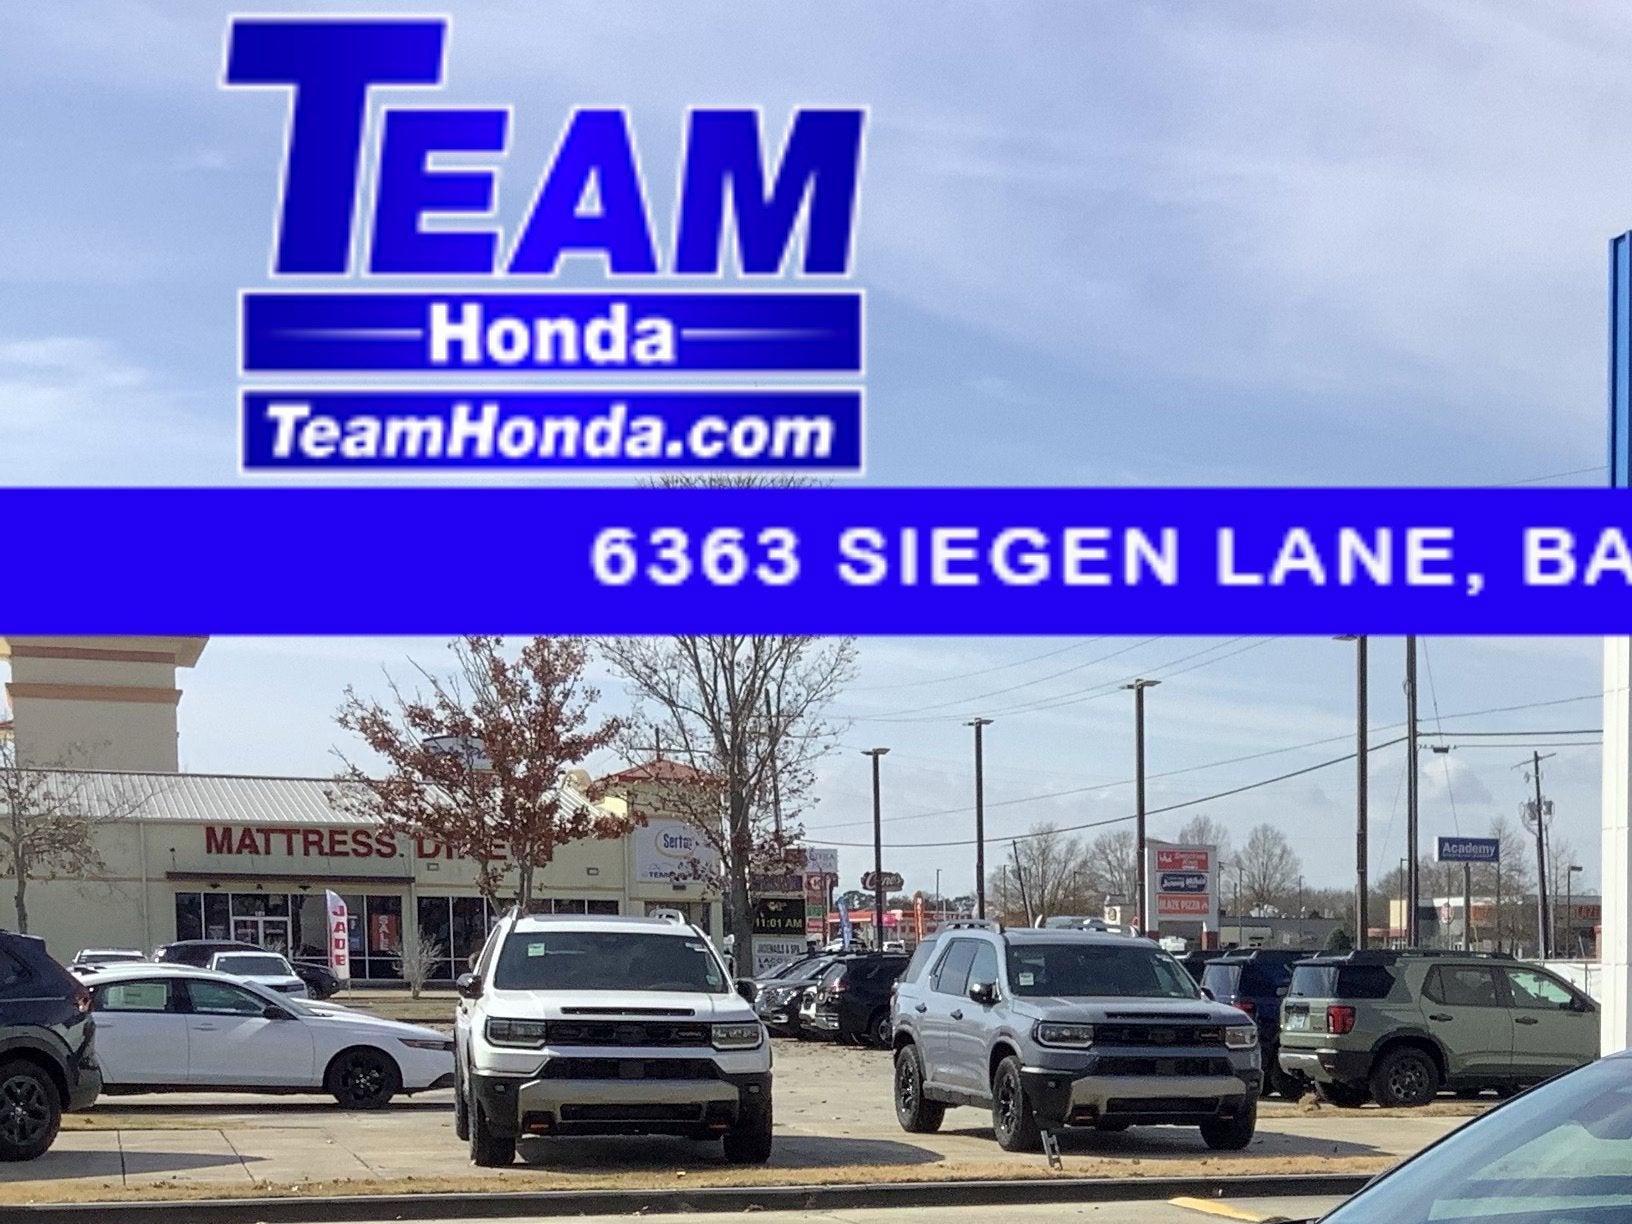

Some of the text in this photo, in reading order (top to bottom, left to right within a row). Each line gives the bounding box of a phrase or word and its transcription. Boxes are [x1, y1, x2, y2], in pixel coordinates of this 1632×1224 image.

[205, 826, 397, 858] MATTRESS
[1443, 842, 1496, 857] Academy
[755, 918, 802, 928] 11:01 AM
[332, 905, 346, 966] JADE
